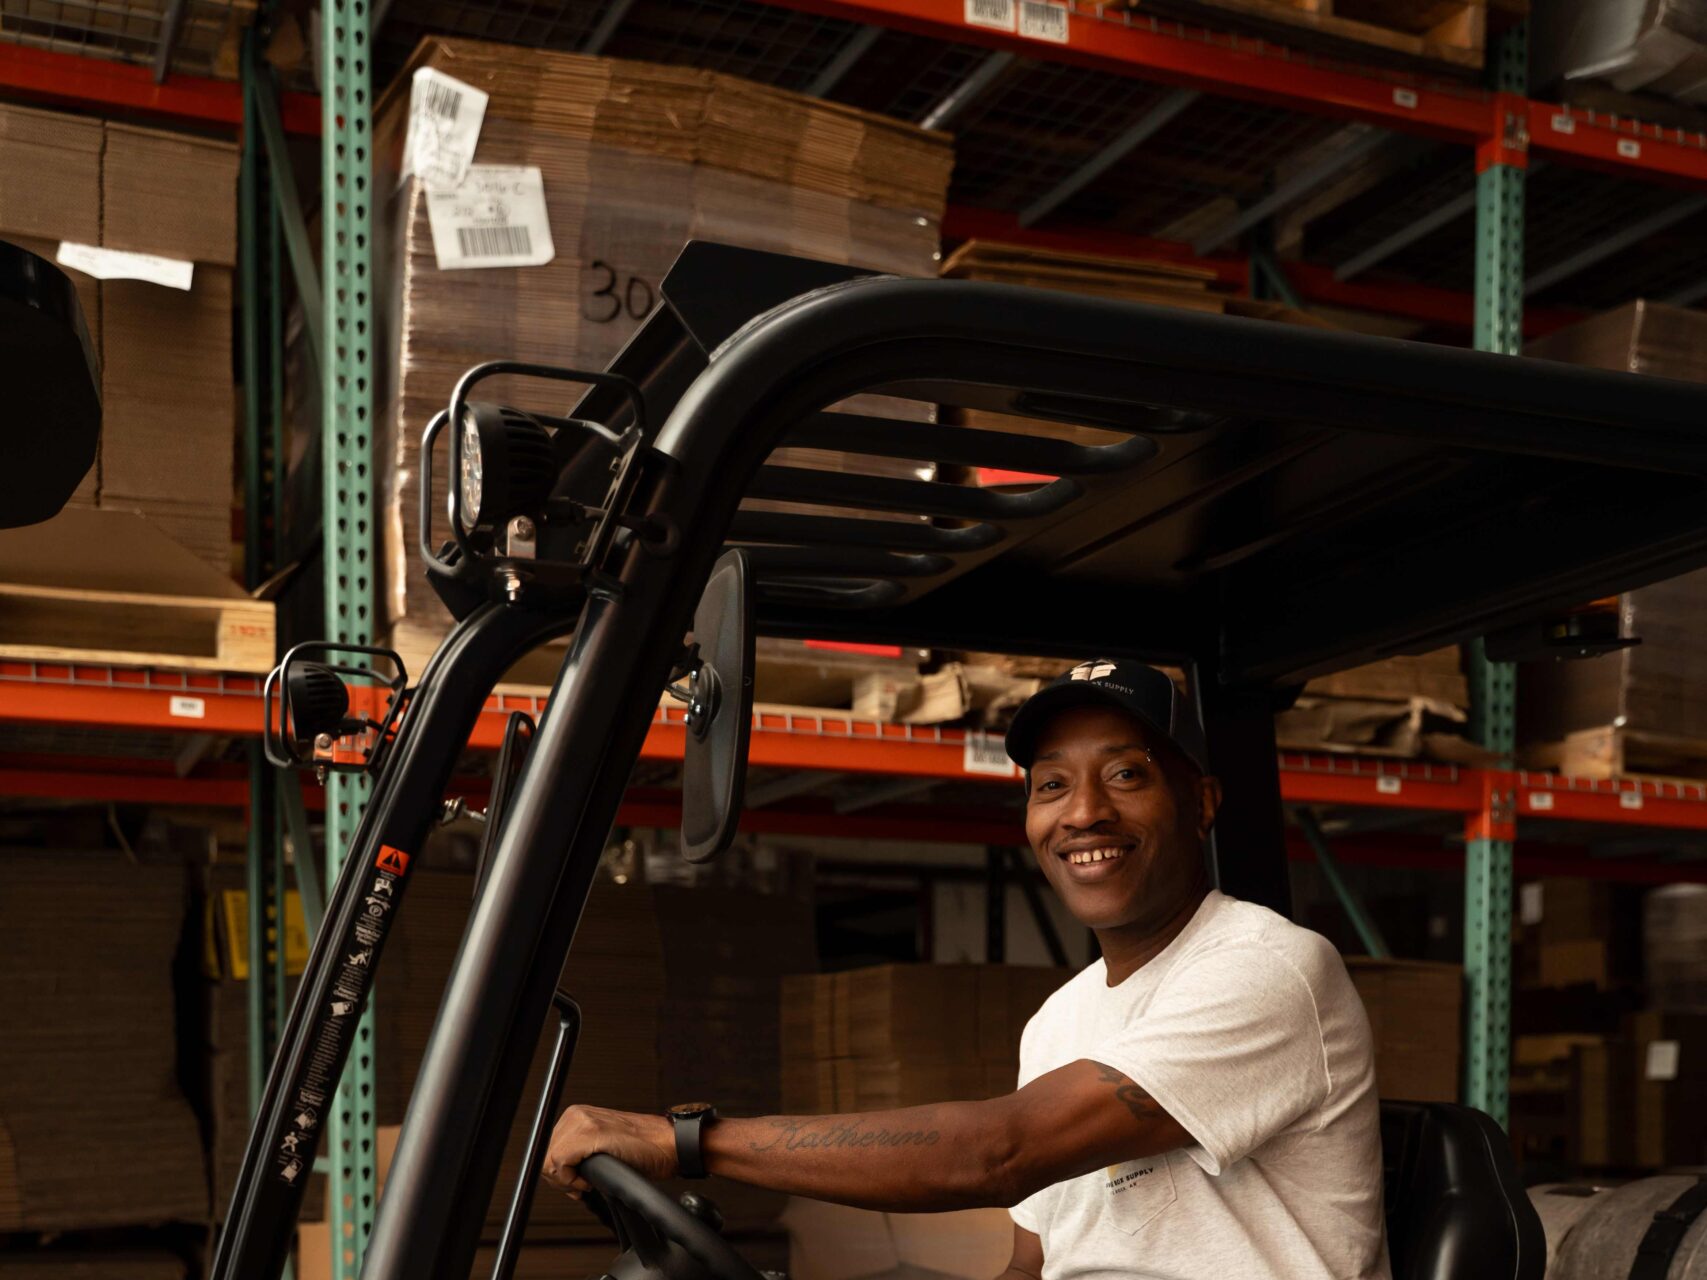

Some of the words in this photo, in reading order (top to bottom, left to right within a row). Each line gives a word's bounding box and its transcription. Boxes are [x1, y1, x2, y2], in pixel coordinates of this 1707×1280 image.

[583, 260, 654, 324] 30
[1105, 682, 1134, 695] SUPPLY
[1125, 1167, 1154, 1181] SUPPLY
